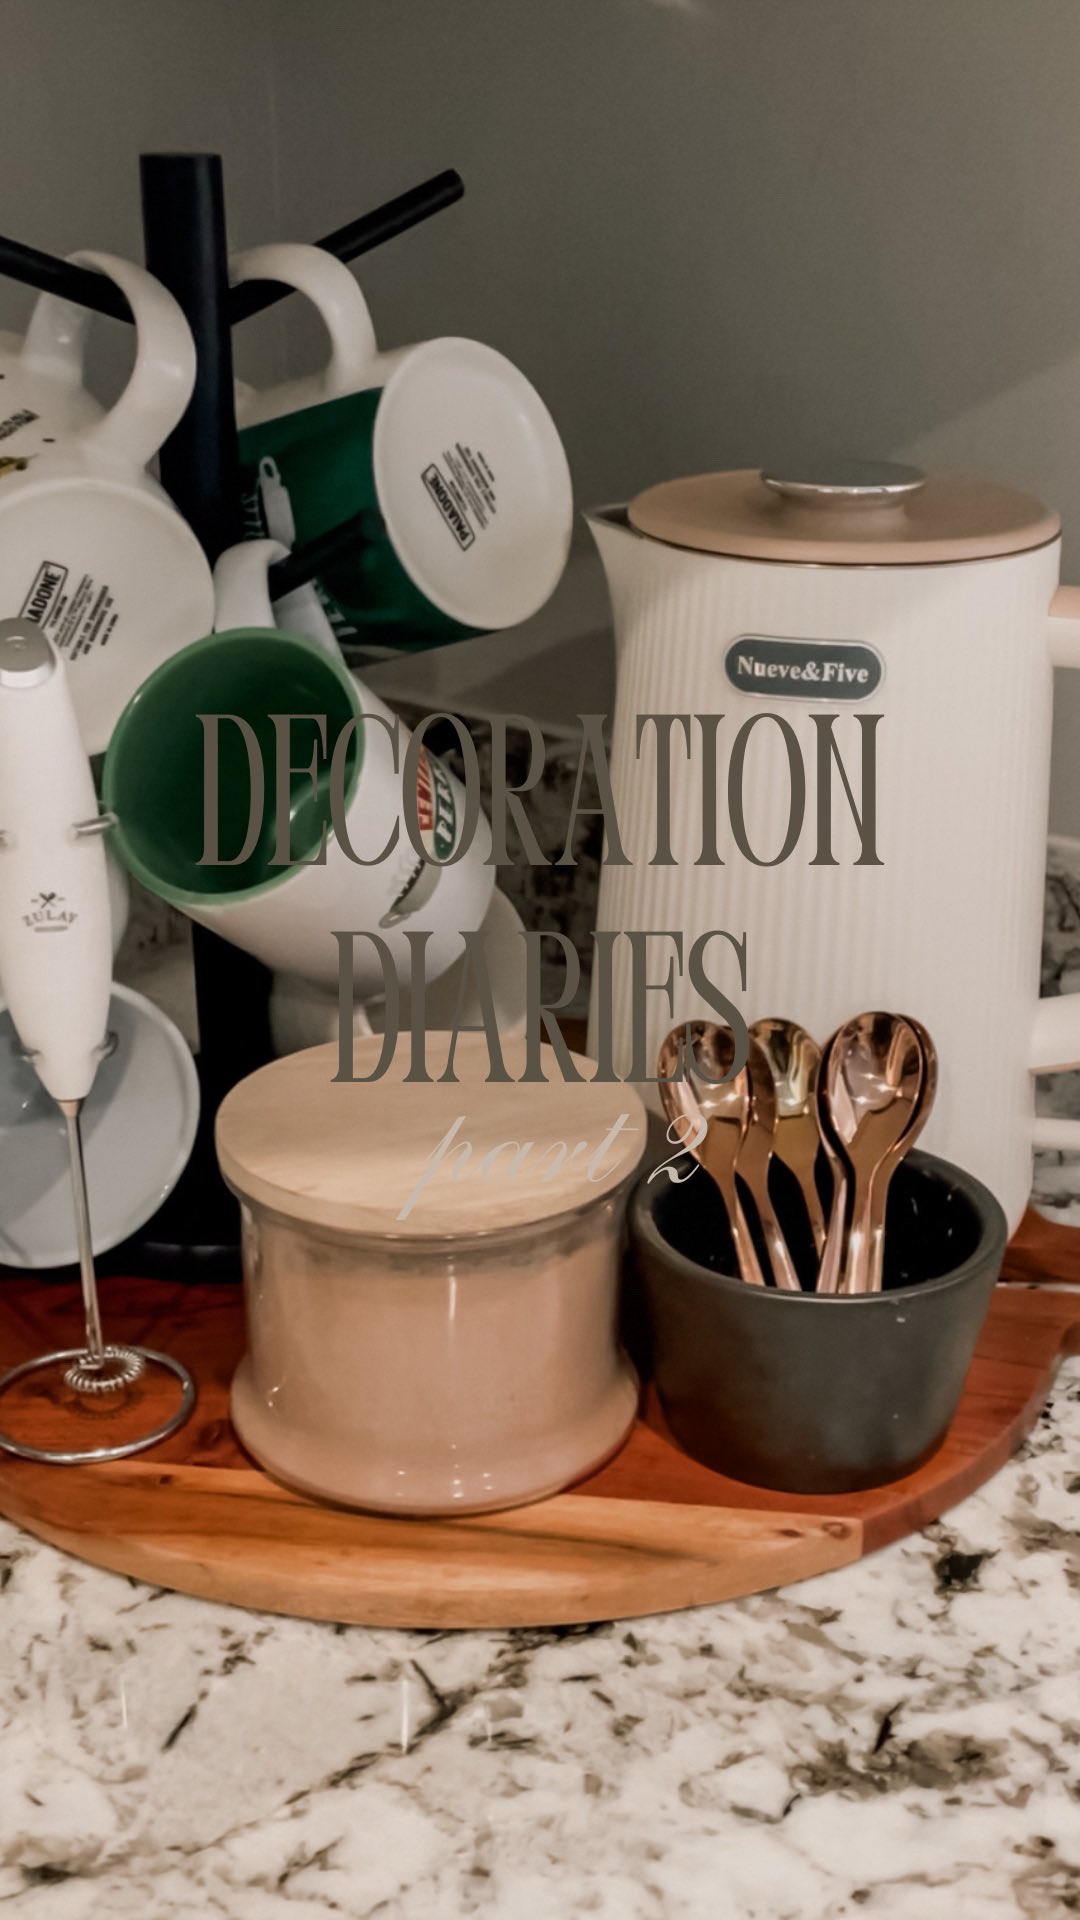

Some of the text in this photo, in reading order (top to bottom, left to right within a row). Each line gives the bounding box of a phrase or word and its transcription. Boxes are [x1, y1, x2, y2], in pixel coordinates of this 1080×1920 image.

[429, 473, 470, 541] PALADONE
[737, 655, 869, 684] Nueve&Five
[22, 910, 78, 927] ZULAY
